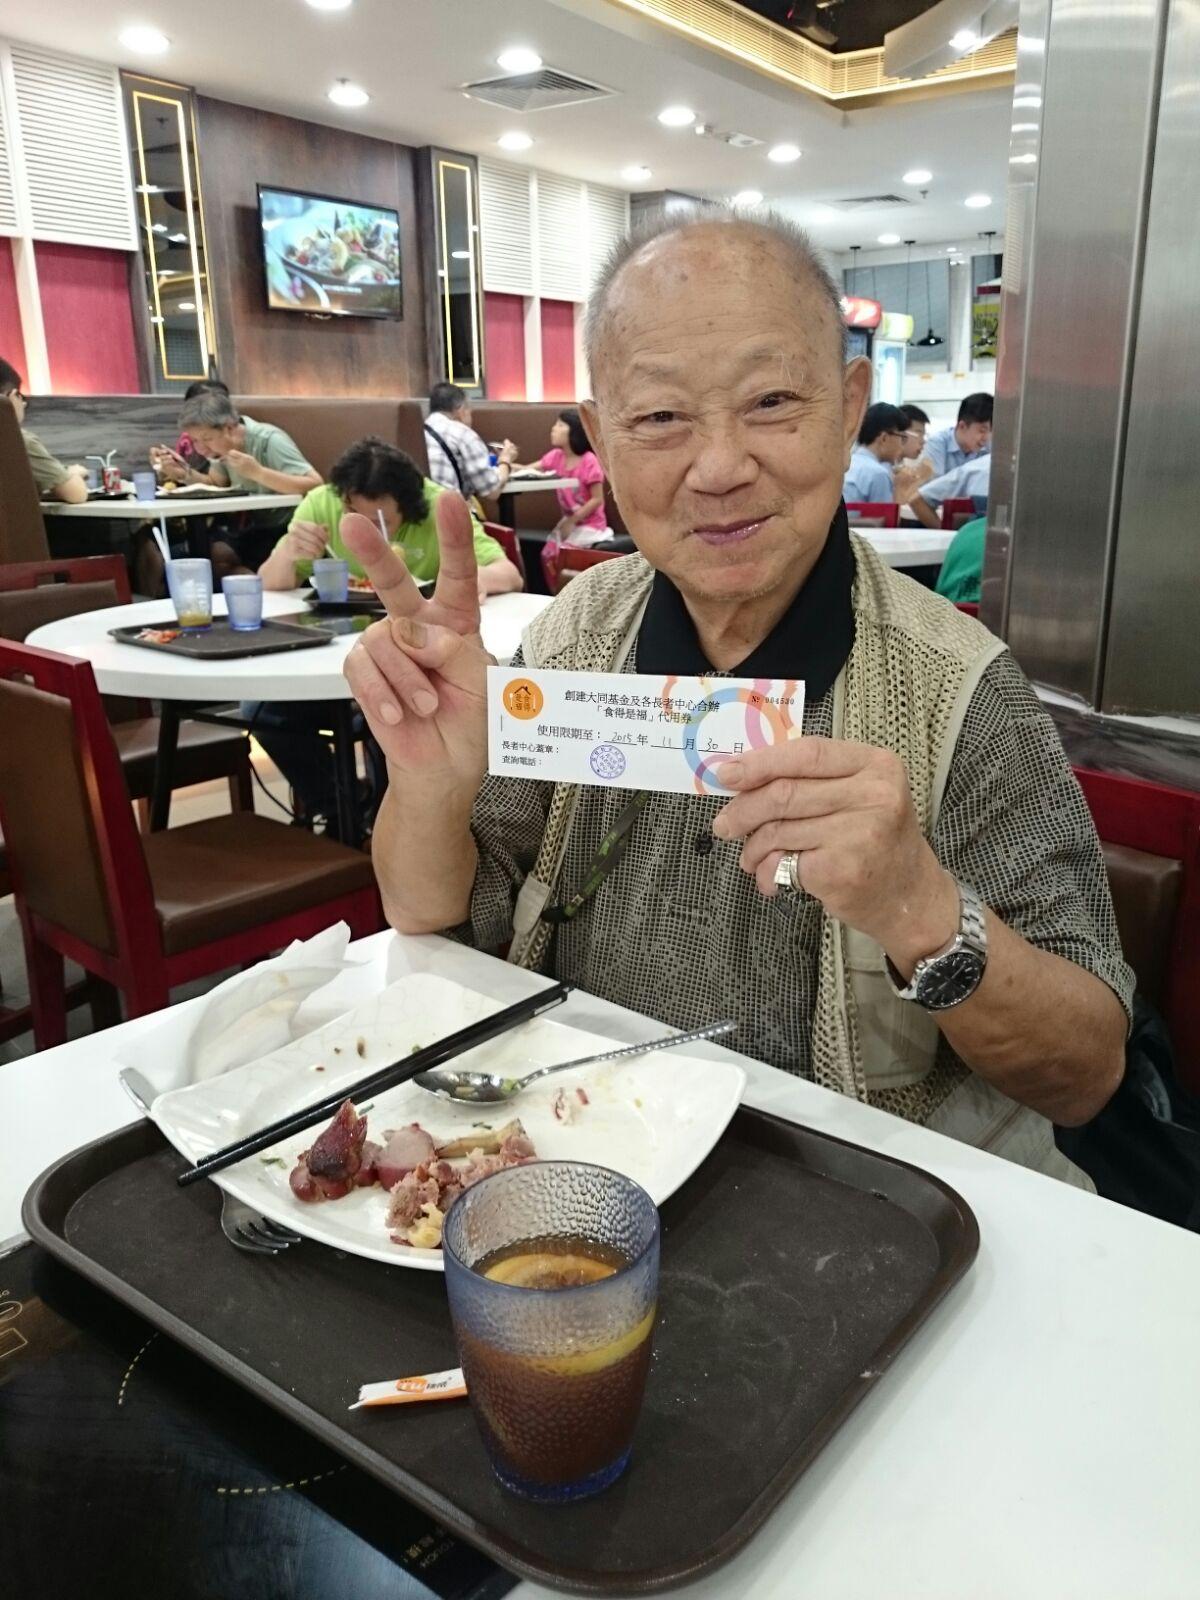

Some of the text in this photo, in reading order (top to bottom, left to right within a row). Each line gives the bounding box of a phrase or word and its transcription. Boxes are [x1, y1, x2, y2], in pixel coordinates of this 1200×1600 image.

[611, 731, 633, 743] 2015
[636, 733, 649, 746] 年
[685, 738, 695, 750] 月
[706, 738, 719, 752] 30
[734, 742, 743, 754] 日
